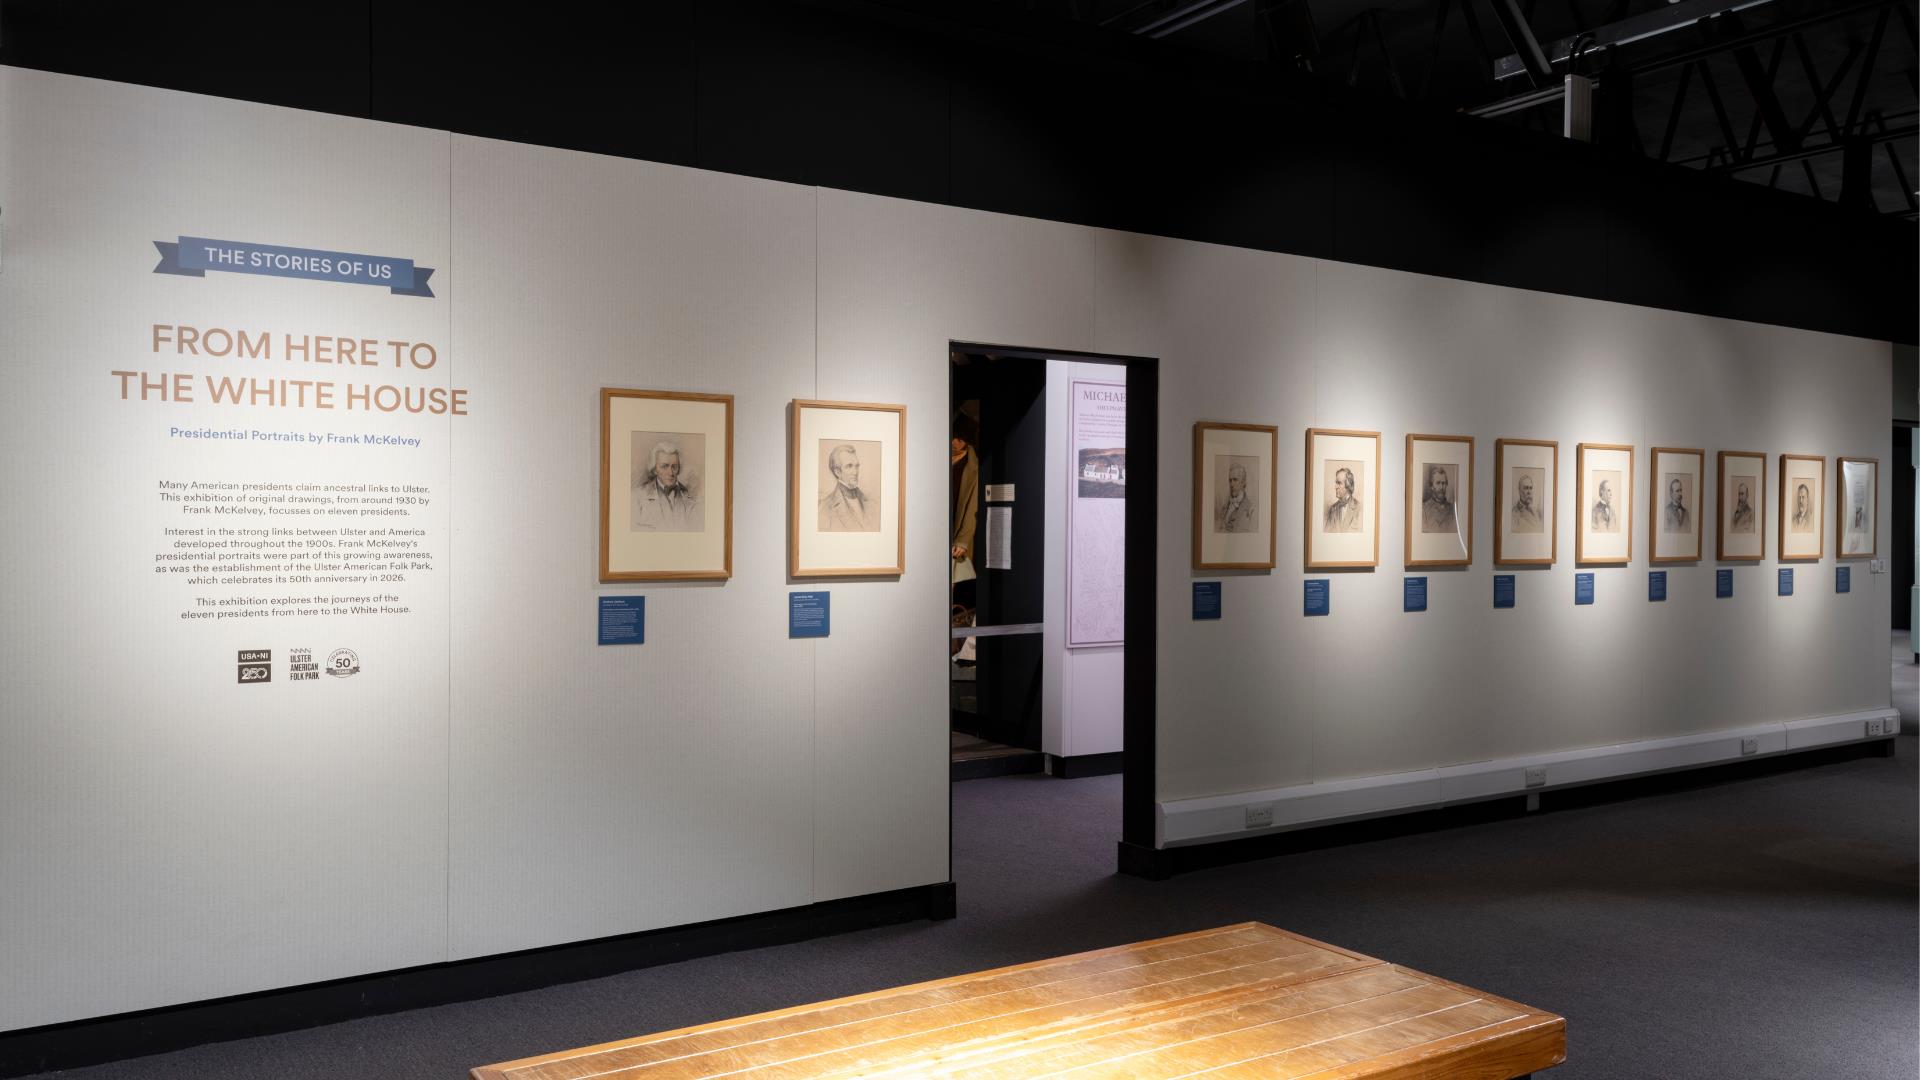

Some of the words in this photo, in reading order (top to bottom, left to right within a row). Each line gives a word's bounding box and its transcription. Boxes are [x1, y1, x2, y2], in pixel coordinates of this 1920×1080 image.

[204, 247, 245, 265] THE
[250, 252, 332, 274] STORIES
[337, 260, 363, 276] OF
[368, 264, 392, 279] US
[152, 324, 271, 360] FROM
[285, 334, 378, 366] HERE
[387, 341, 437, 370] TO
[111, 370, 194, 403] THE
[205, 375, 334, 409] WHITE
[347, 383, 468, 416] HOUSE
[170, 427, 247, 440] Presidential
[252, 430, 305, 442] Portraits
[308, 432, 323, 445] by
[327, 433, 360, 444] Frank
[364, 434, 421, 447] McKelvey
[159, 480, 188, 491] Many
[191, 481, 239, 490] American
[242, 482, 293, 492] presidents
[296, 483, 321, 492] claim
[324, 484, 366, 492] ancestral
[368, 484, 389, 493] links
[391, 485, 400, 493] to
[402, 485, 430, 494] Ulster.
[160, 492, 181, 502] This
[184, 493, 233, 502] exhibition
[236, 493, 246, 503] of
[249, 494, 285, 505] original
[288, 495, 334, 505] drawings,
[337, 495, 359, 504] from
[396, 496, 417, 505] 1930
[418, 497, 429, 507] by
[183, 505, 211, 514] Frank
[214, 505, 266, 516] McKelvey,
[269, 506, 311, 515] focusses
[328, 507, 358, 516] eleven
[360, 508, 410, 517] presidents.
[165, 528, 203, 536] Interest
[207, 527, 216, 536] in
[219, 528, 235, 536] the
[238, 529, 269, 538] strong
[272, 527, 293, 536] links
[296, 528, 337, 536] between
[340, 528, 366, 536] Ulster
[369, 528, 385, 536] and
[388, 528, 425, 536] America
[174, 540, 227, 549] developed
[230, 540, 285, 550] throughout
[288, 539, 303, 548] the
[306, 539, 335, 548] 1900s.
[338, 539, 363, 548] Frank
[366, 539, 417, 549] McKelvey's
[156, 551, 215, 562] presidential
[218, 552, 261, 562] portraits
[290, 552, 309, 561] part
[312, 551, 321, 560] of
[324, 551, 341, 559] this
[344, 551, 381, 561] growing
[193, 564, 209, 573] the
[212, 563, 281, 572] establishment
[284, 563, 293, 572] of
[296, 563, 311, 571] the
[314, 563, 341, 571] Ulster
[344, 562, 387, 571] American
[390, 562, 408, 570] Folk
[411, 561, 433, 571] Park,
[188, 576, 218, 585] which
[221, 576, 273, 584] celebrates
[276, 574, 287, 584] its
[290, 575, 311, 583] 50th
[314, 575, 367, 583] anniversary
[370, 574, 377, 582] in
[380, 574, 405, 582] 2026.
[196, 597, 216, 606] This
[219, 597, 268, 606] exhibition
[270, 596, 311, 606] explores
[314, 595, 329, 604] the
[331, 596, 371, 605] journeys
[373, 594, 382, 603] of
[384, 594, 399, 602] the
[181, 611, 215, 619] eleven
[218, 609, 269, 620] presidents
[272, 608, 295, 617] from
[297, 608, 319, 616] here
[333, 607, 347, 615] the
[350, 606, 378, 614] White
[380, 605, 411, 614] House.
[290, 655, 312, 663] ULSTER
[336, 658, 351, 668] 50
[290, 663, 319, 671] AMERICAN
[290, 672, 305, 680] FOLK
[305, 671, 320, 680] PARK
